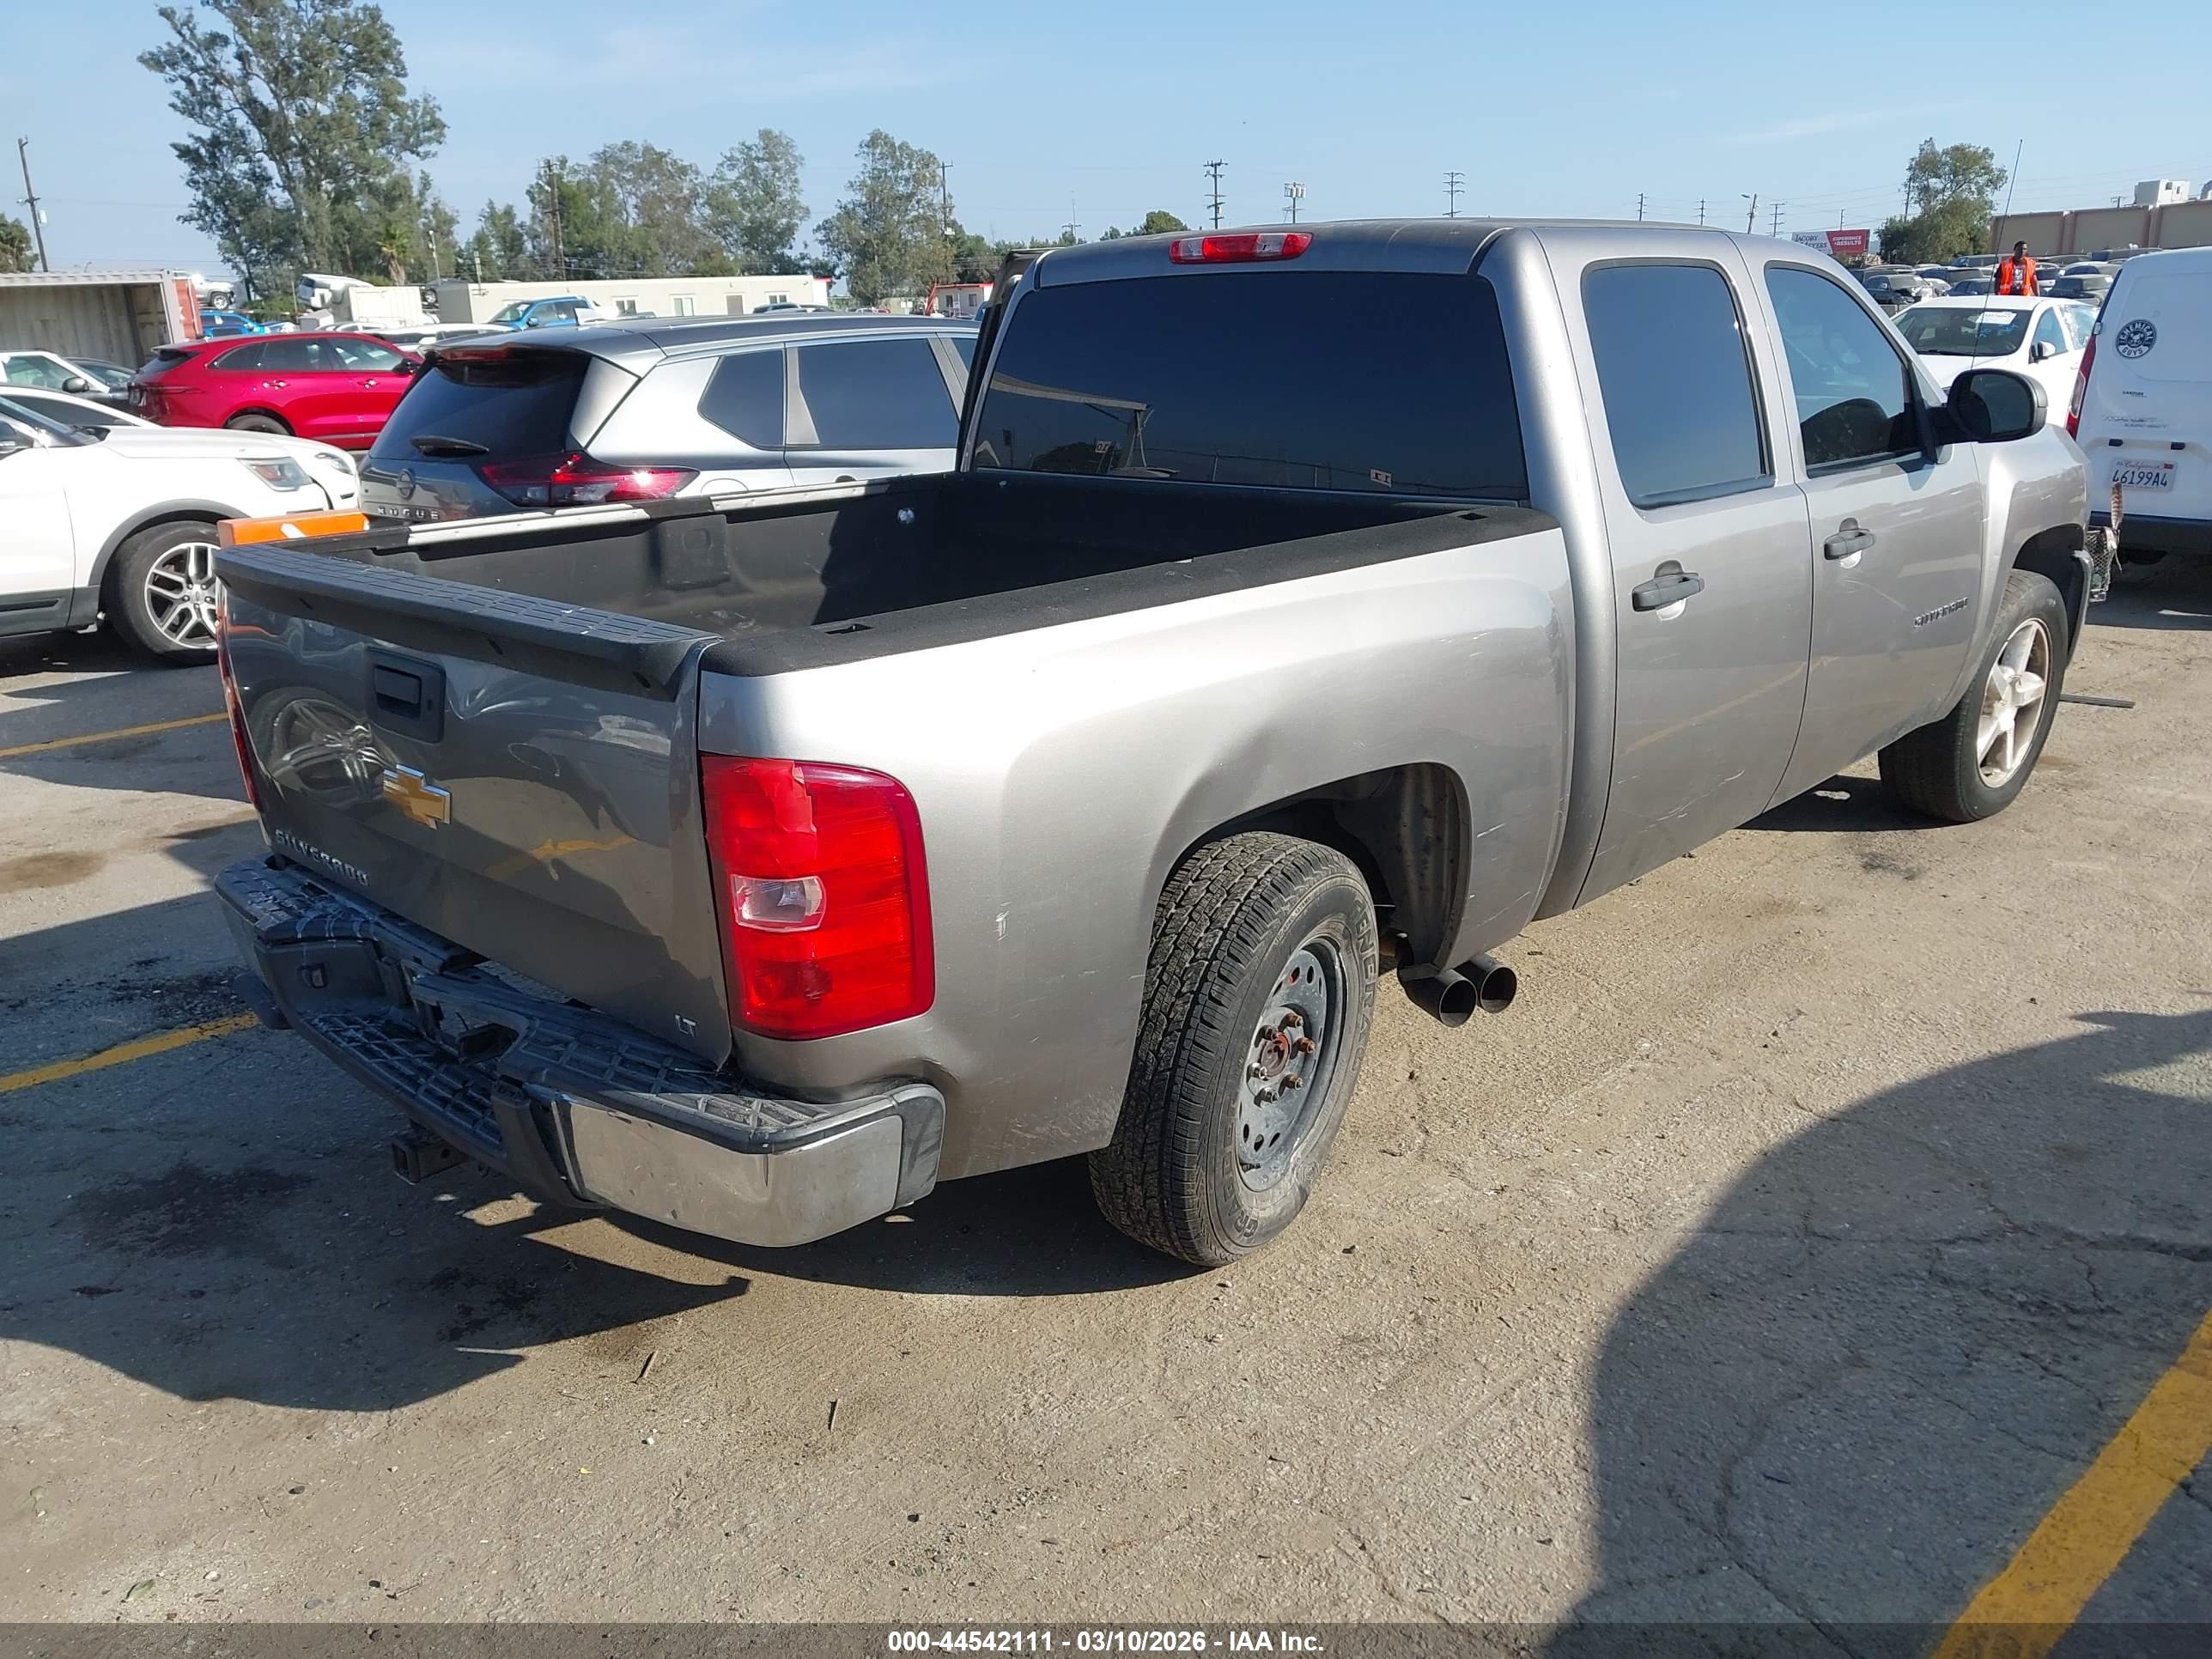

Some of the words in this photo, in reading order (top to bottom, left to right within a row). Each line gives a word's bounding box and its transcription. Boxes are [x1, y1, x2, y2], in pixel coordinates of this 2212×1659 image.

[2119, 322, 2154, 341] CHEMICAL
[2122, 345, 2143, 356] GUYS
[2112, 469, 2167, 487] 46199A4
[378, 507, 440, 520] ROGUE
[275, 829, 370, 886] SILVERADO
[674, 1013, 697, 1037] LT
